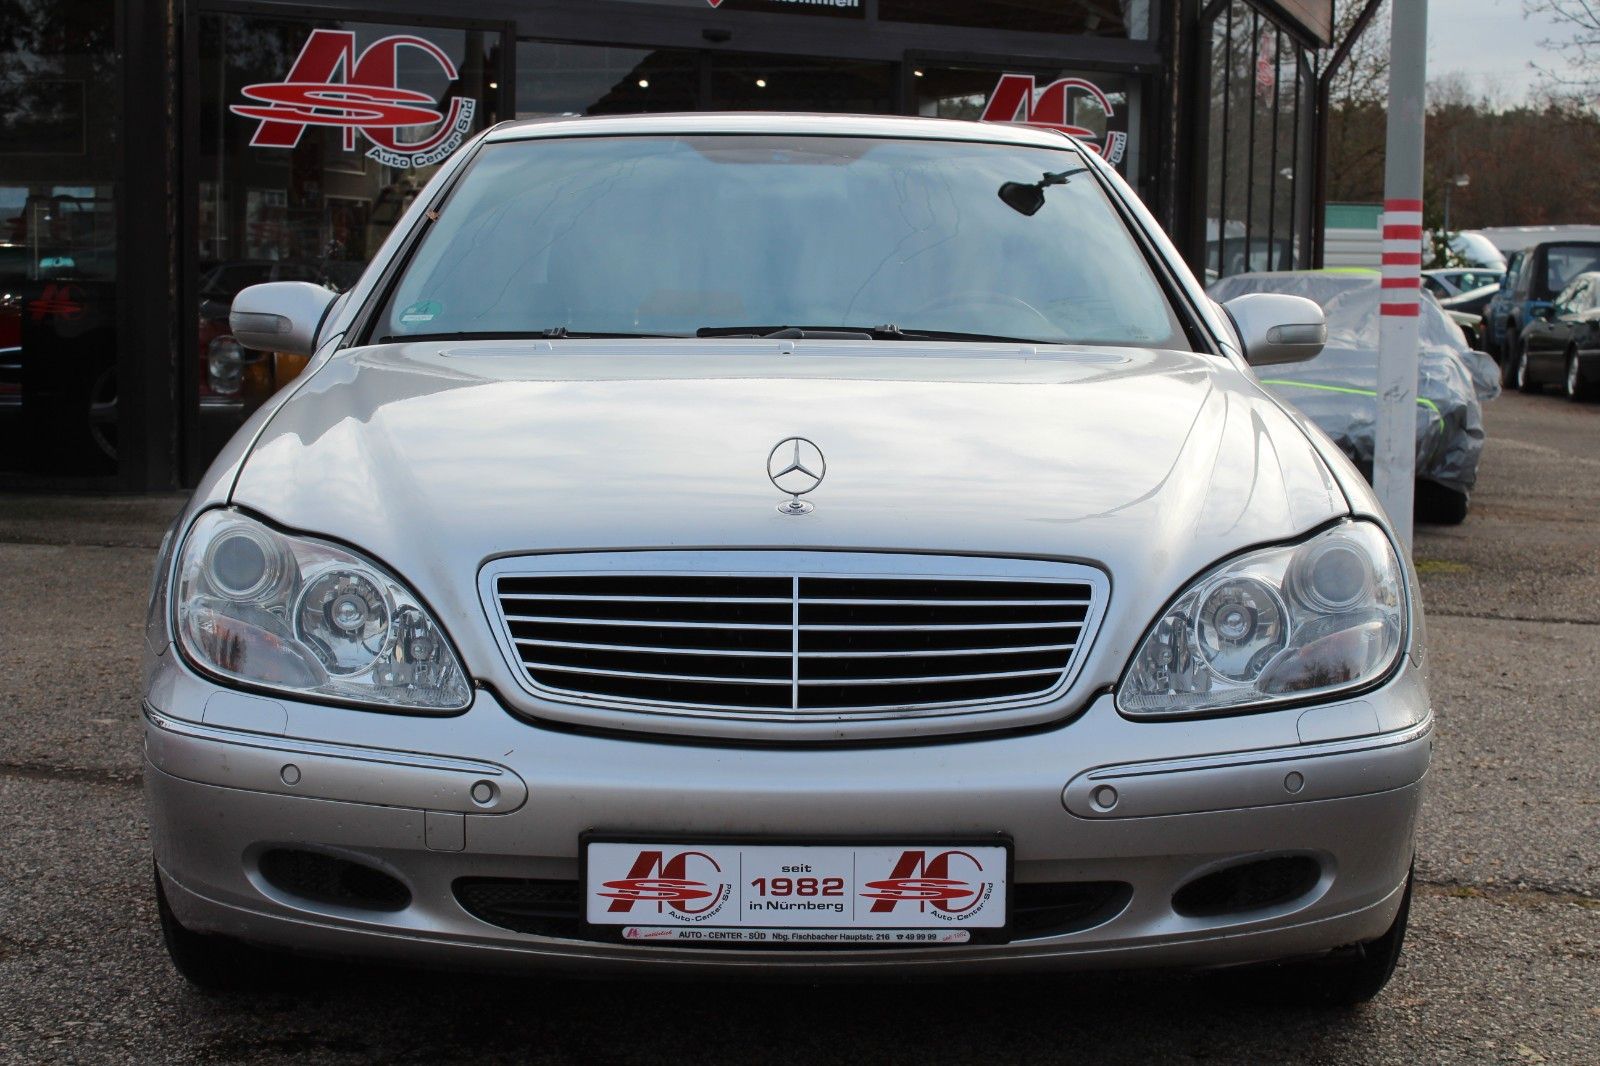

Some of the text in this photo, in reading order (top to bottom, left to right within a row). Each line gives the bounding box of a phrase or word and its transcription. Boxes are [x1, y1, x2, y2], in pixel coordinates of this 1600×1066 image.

[367, 98, 474, 167] Auto Center Süd
[781, 864, 812, 873] seit
[751, 878, 844, 897] 1982
[668, 884, 731, 922] Auto-Center-Süd
[749, 901, 844, 912] in Nürnberg
[930, 882, 993, 921] Auto-Center-Süd
[679, 931, 701, 939] AUTO
[708, 931, 743, 940] CENTER
[749, 930, 766, 940] SÜD
[772, 932, 790, 941] Nbg.
[792, 932, 838, 941] Fischbacher
[840, 932, 874, 942] Hauptstr.
[875, 933, 890, 941] 216
[905, 933, 915, 941] 49
[917, 933, 926, 941] 99
[928, 933, 937, 941] 99
